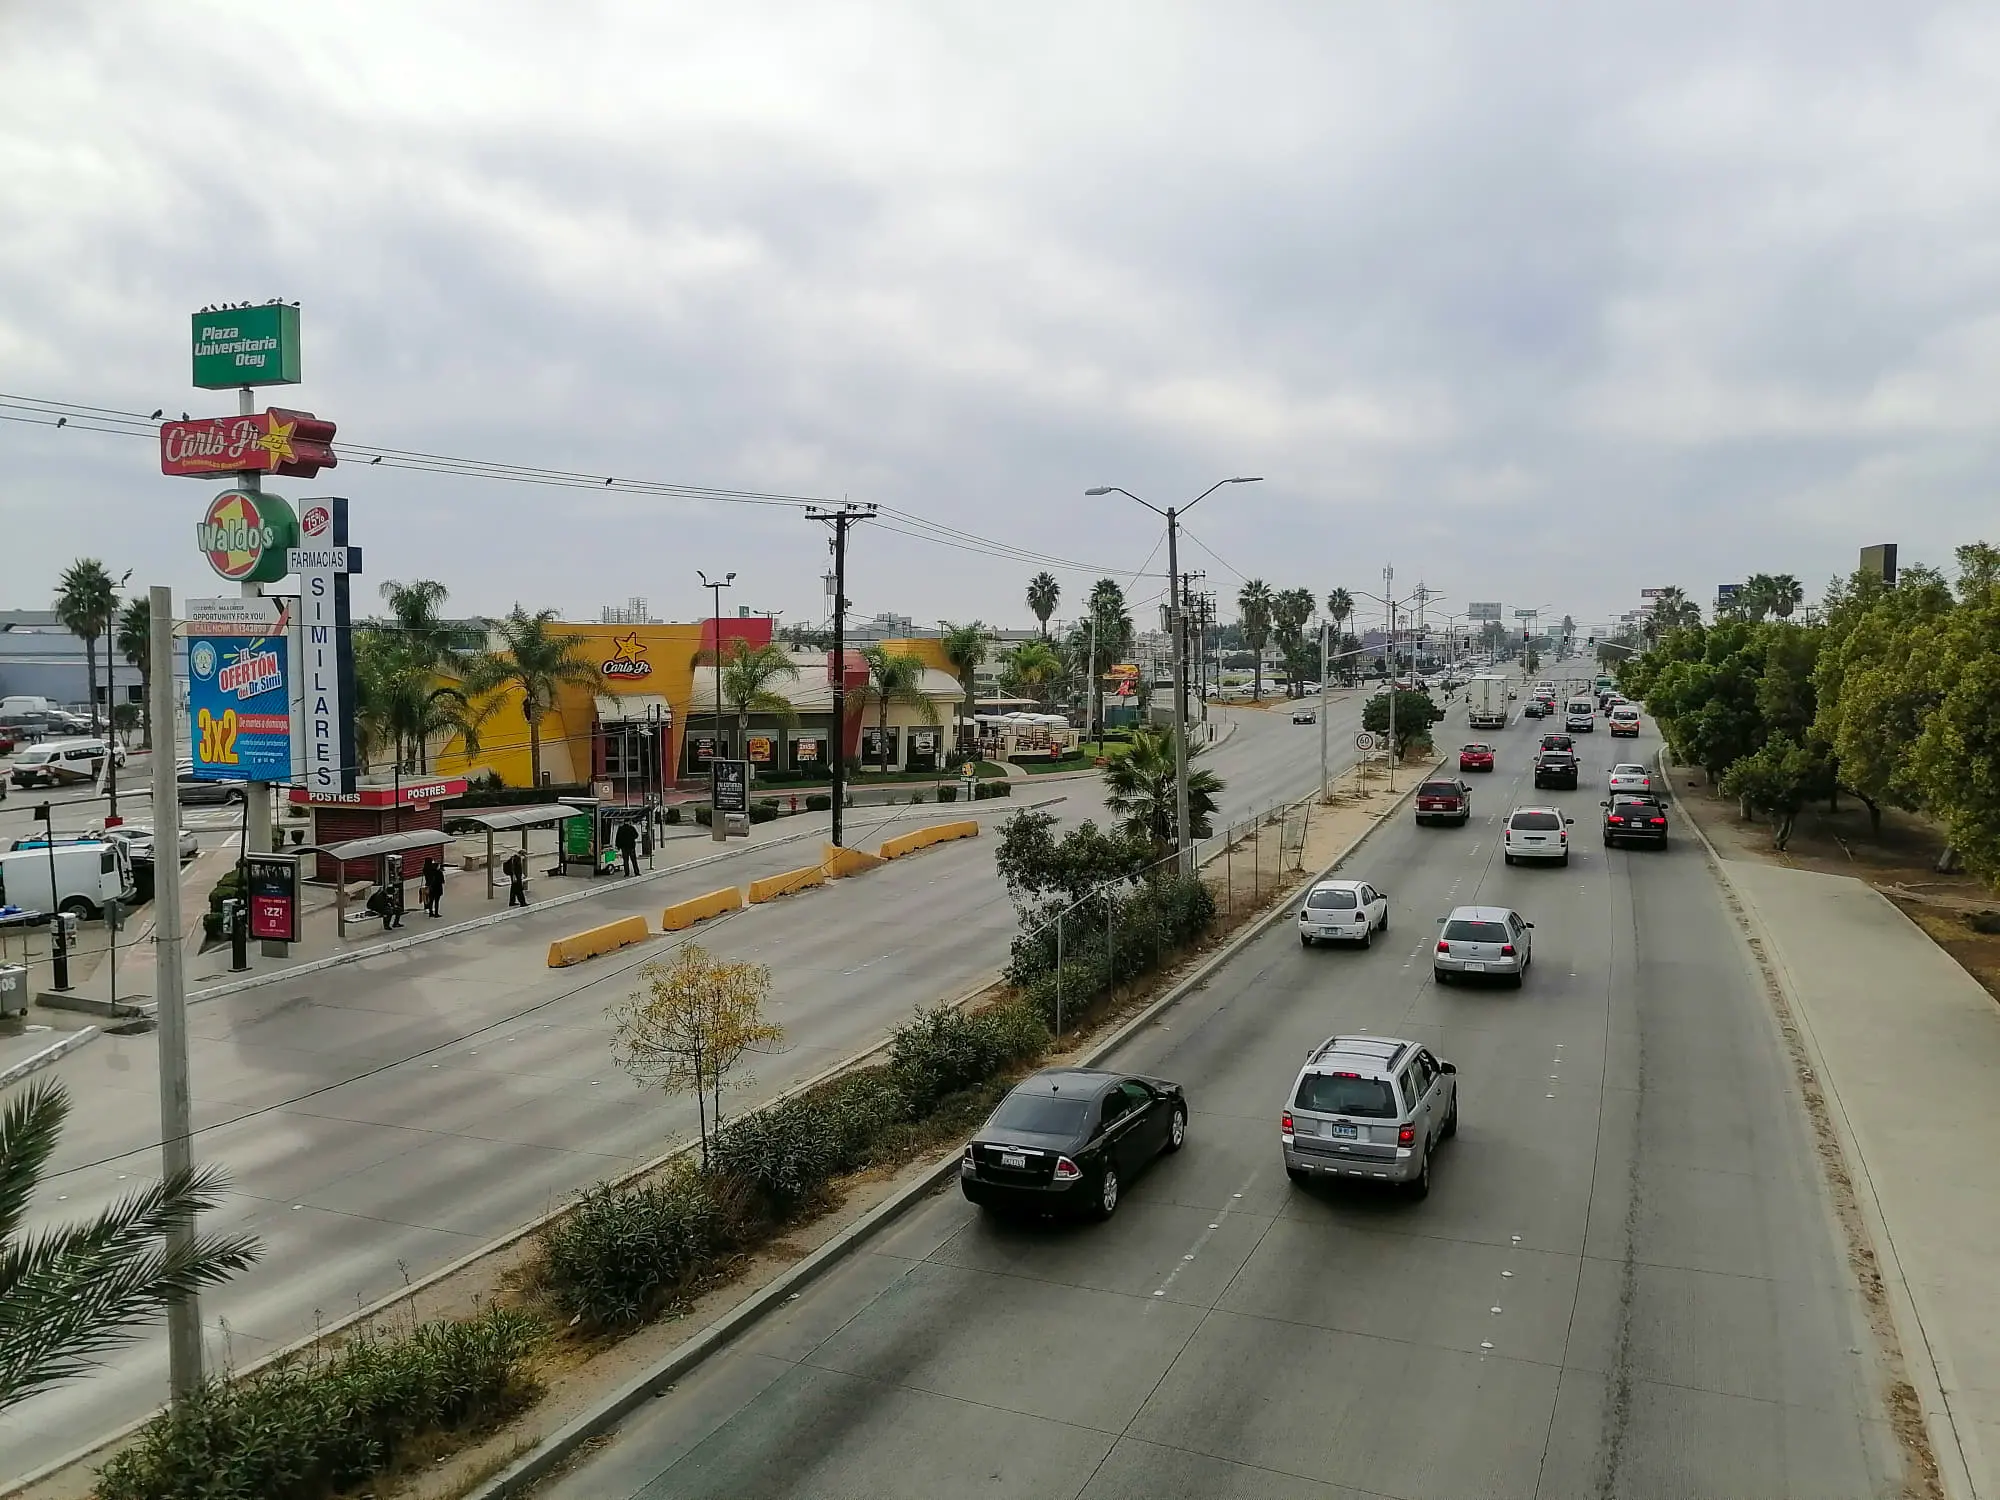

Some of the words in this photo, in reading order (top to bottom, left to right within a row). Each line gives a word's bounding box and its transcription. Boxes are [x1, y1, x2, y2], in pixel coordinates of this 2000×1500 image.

[202, 327, 238, 340] Plaza
[195, 336, 277, 356] Universitaria
[235, 353, 265, 367] Otay
[197, 518, 274, 552] Waldo's
[291, 551, 344, 568] FARMACIAS
[193, 613, 235, 621] OPPORTUNITY
[237, 613, 249, 621] FOR
[250, 612, 267, 621] YOU!
[220, 652, 277, 691] OFERTÓN
[261, 674, 281, 691] Simi
[311, 577, 331, 786] SIMILARES
[1360, 736, 1370, 745] 60
[309, 792, 361, 803] POSTRES
[408, 785, 446, 800] POSTRES
